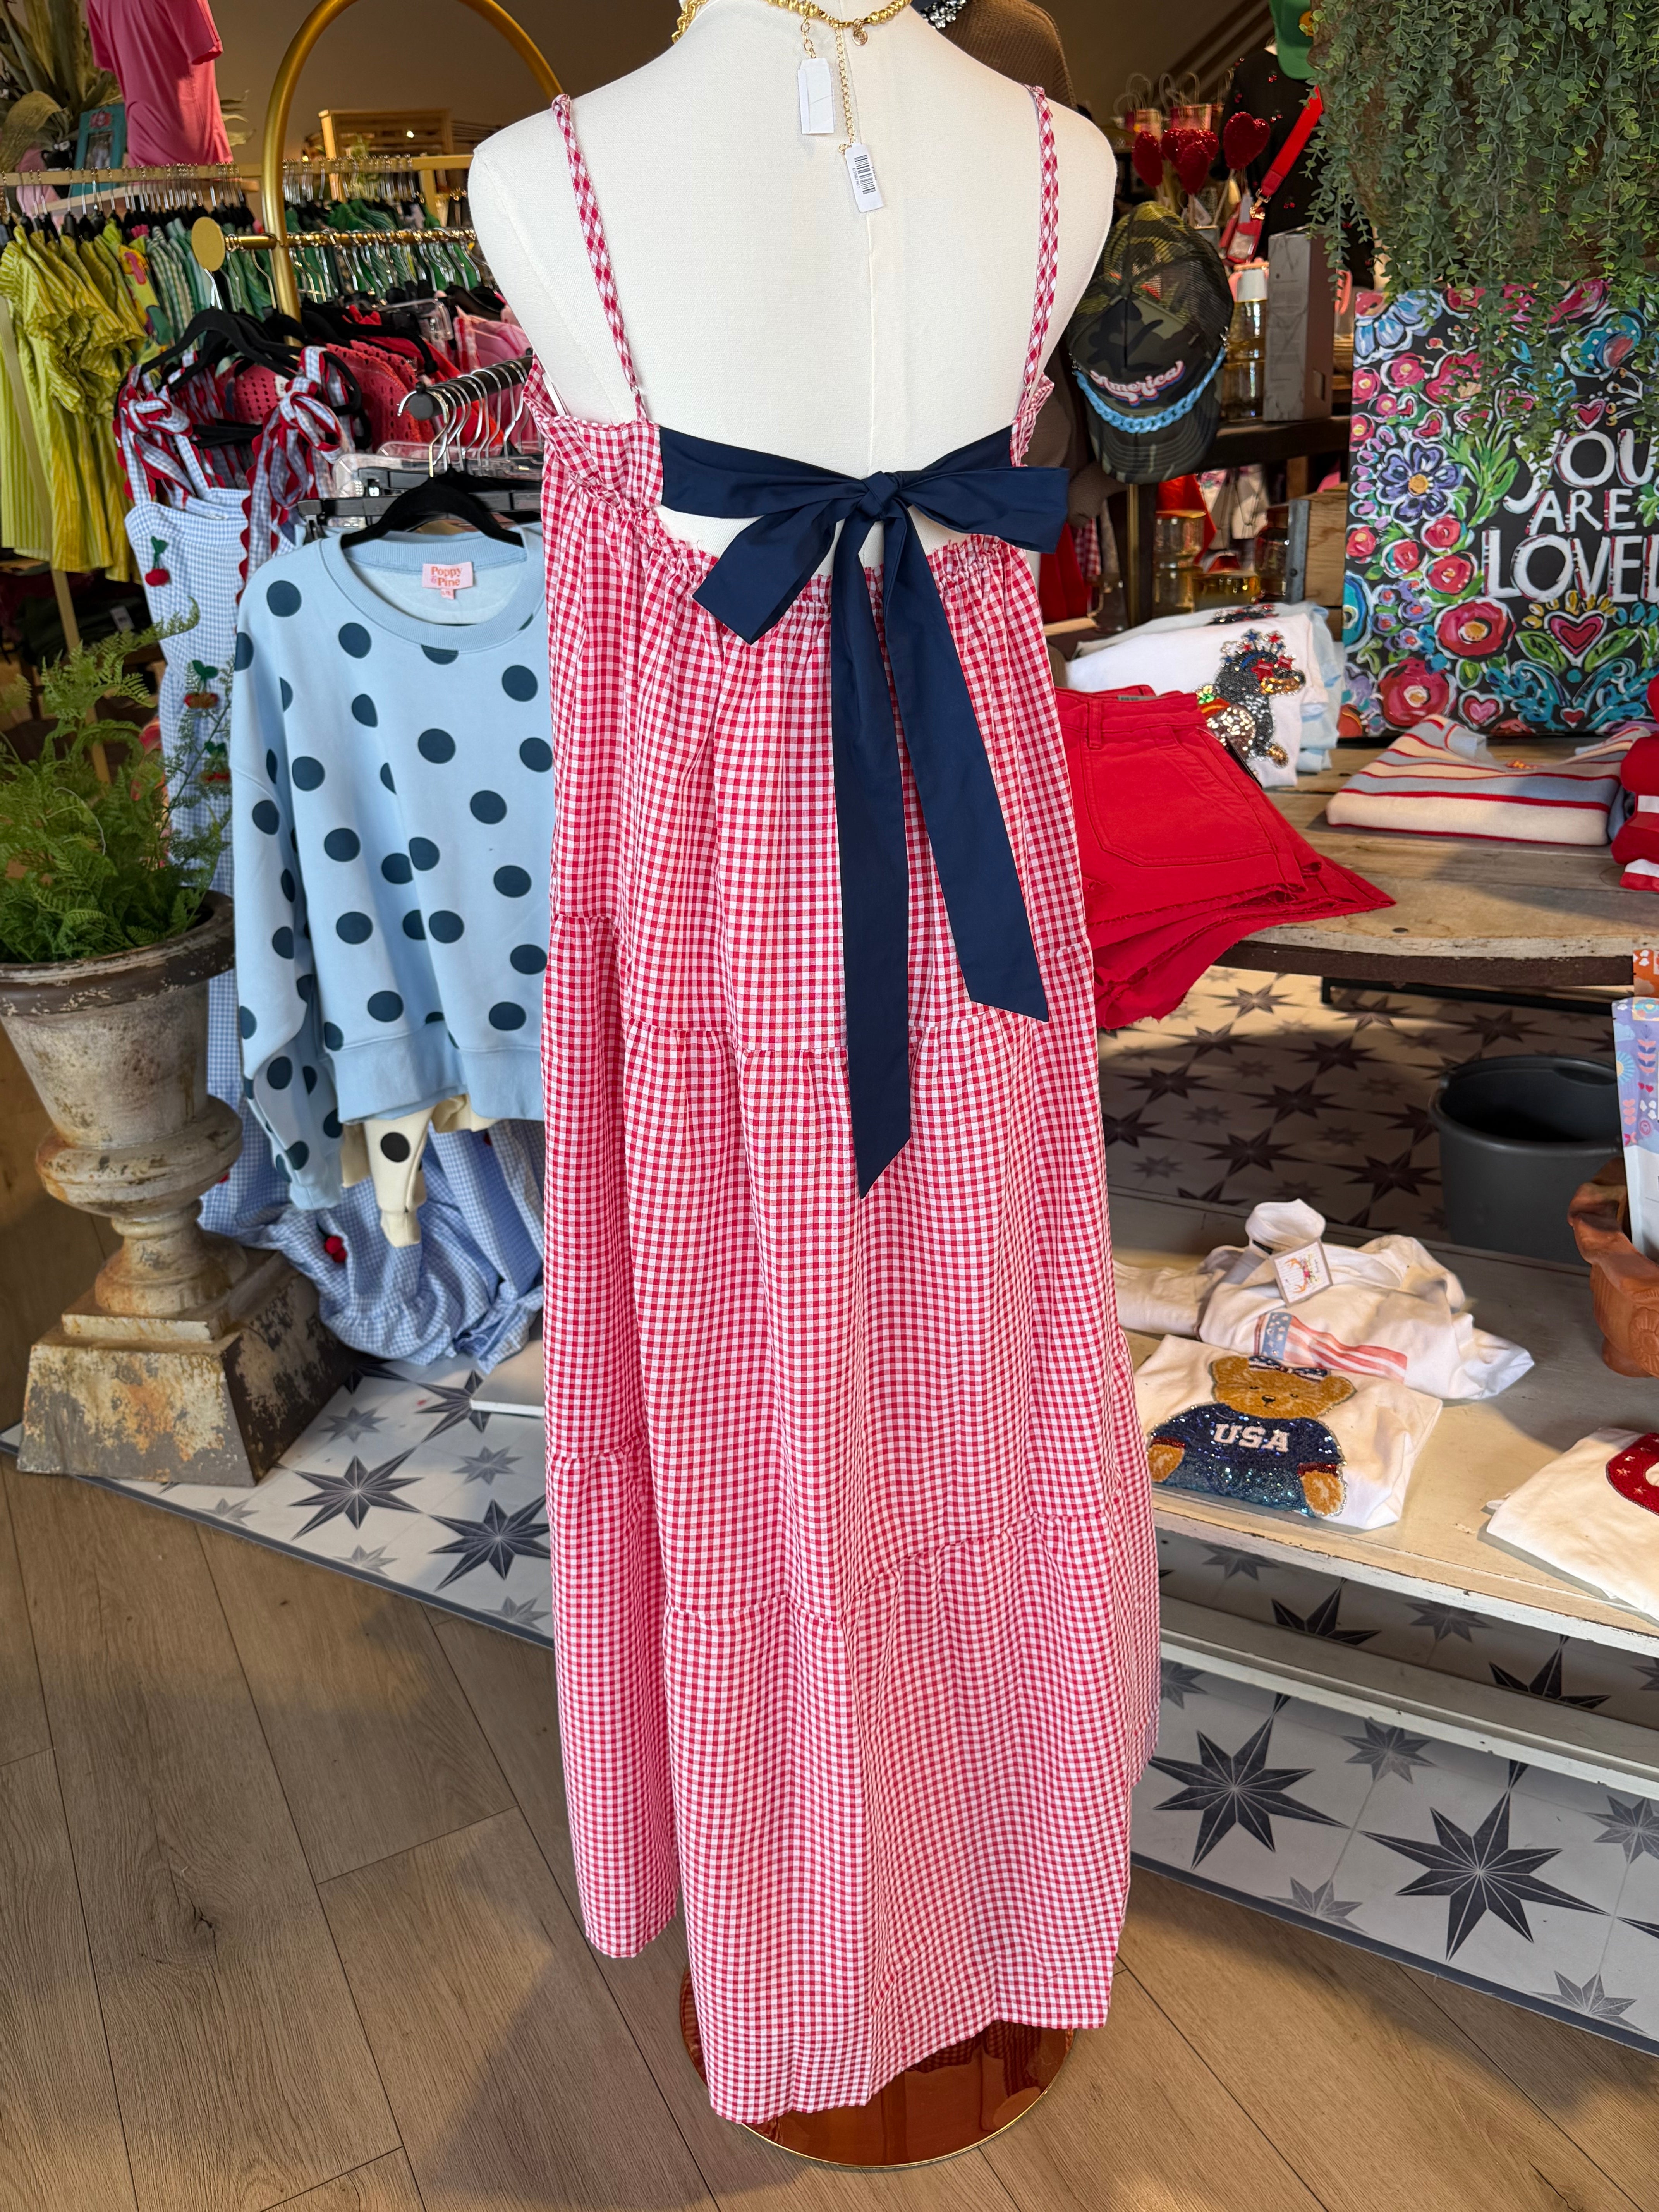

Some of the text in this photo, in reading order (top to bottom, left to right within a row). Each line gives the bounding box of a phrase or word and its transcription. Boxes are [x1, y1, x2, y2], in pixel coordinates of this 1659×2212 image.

[1089, 360, 1186, 407] America
[1525, 488, 1636, 536] ARE
[430, 566, 462, 578] Poppy
[438, 577, 460, 587] Pine
[1213, 1423, 1290, 1453] USA
